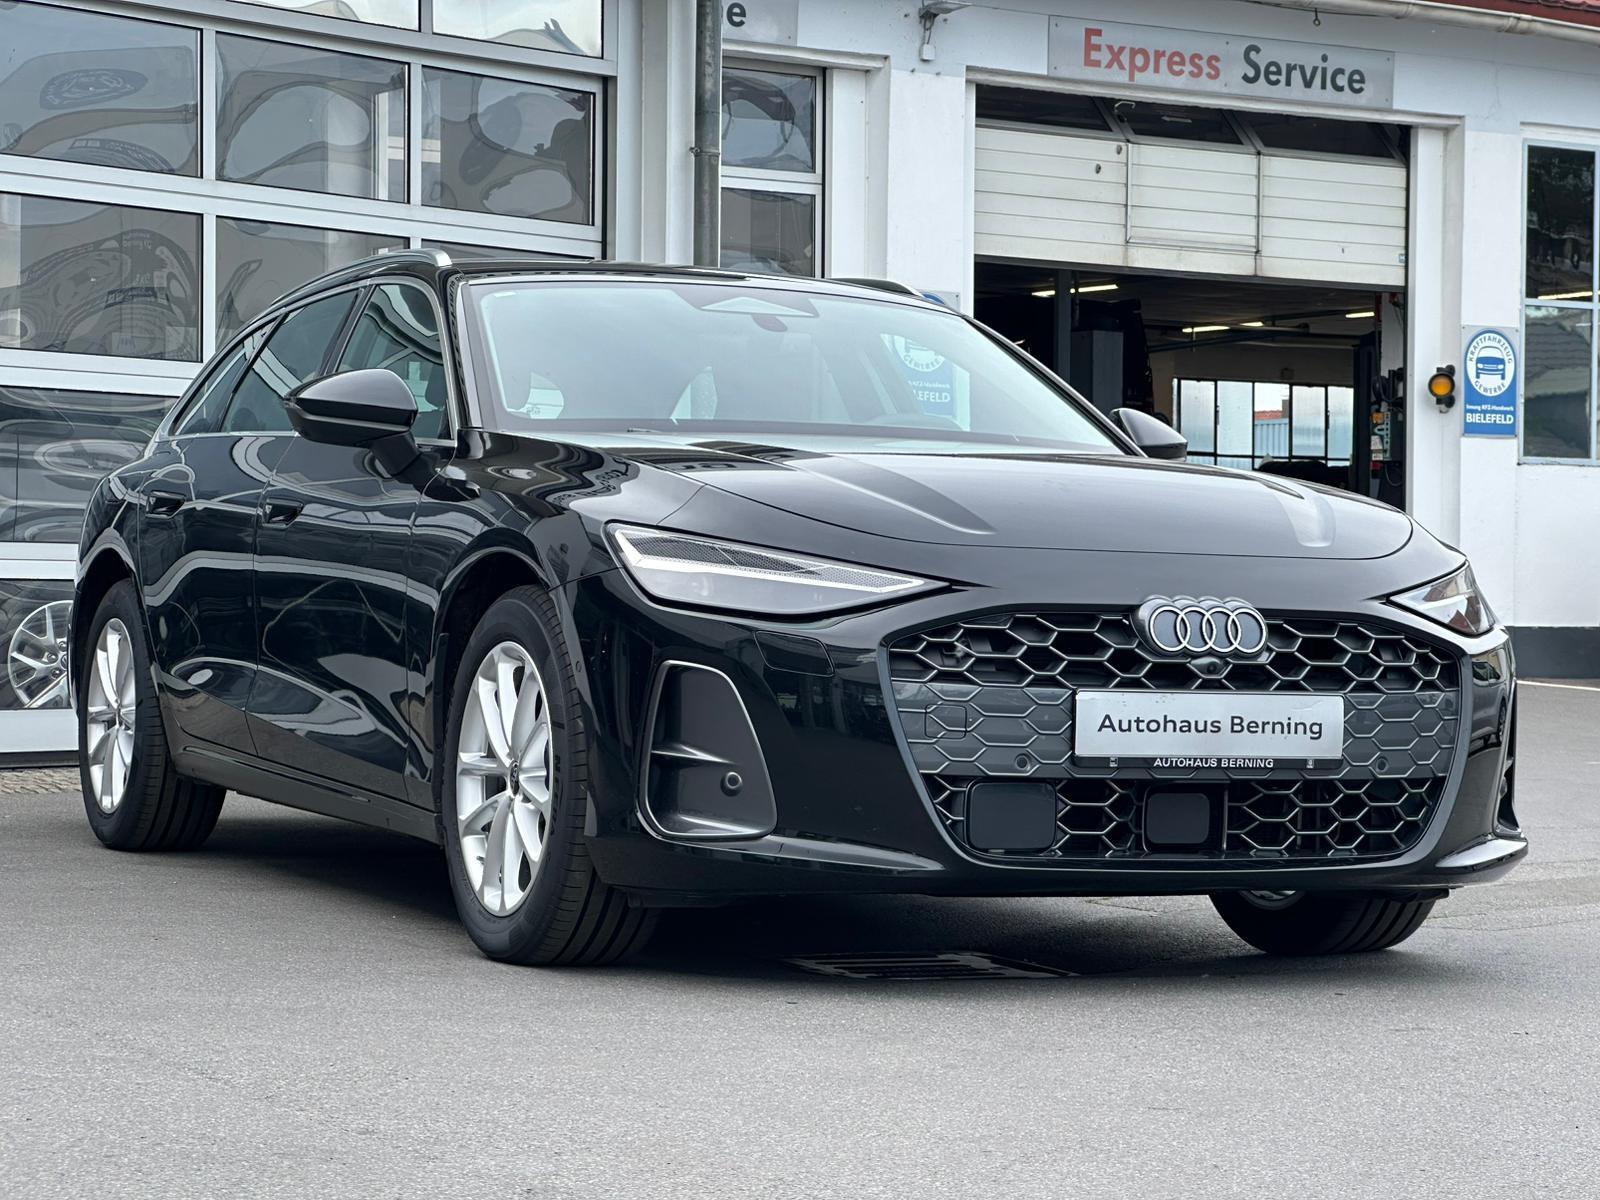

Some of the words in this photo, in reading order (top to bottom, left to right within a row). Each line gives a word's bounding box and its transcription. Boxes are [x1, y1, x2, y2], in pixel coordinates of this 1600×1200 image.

[1083, 27, 1222, 82] Express
[1241, 44, 1366, 95] Service
[1469, 335, 1512, 364] KRAFTFAHRZEUG
[1475, 380, 1506, 394] GEWERBE
[1466, 413, 1514, 424] BIELEFELD
[1097, 714, 1222, 734] Autohaus
[1229, 716, 1323, 740] Berning
[1153, 757, 1218, 768] AUTOHAUS
[1220, 758, 1274, 768] BERNING
